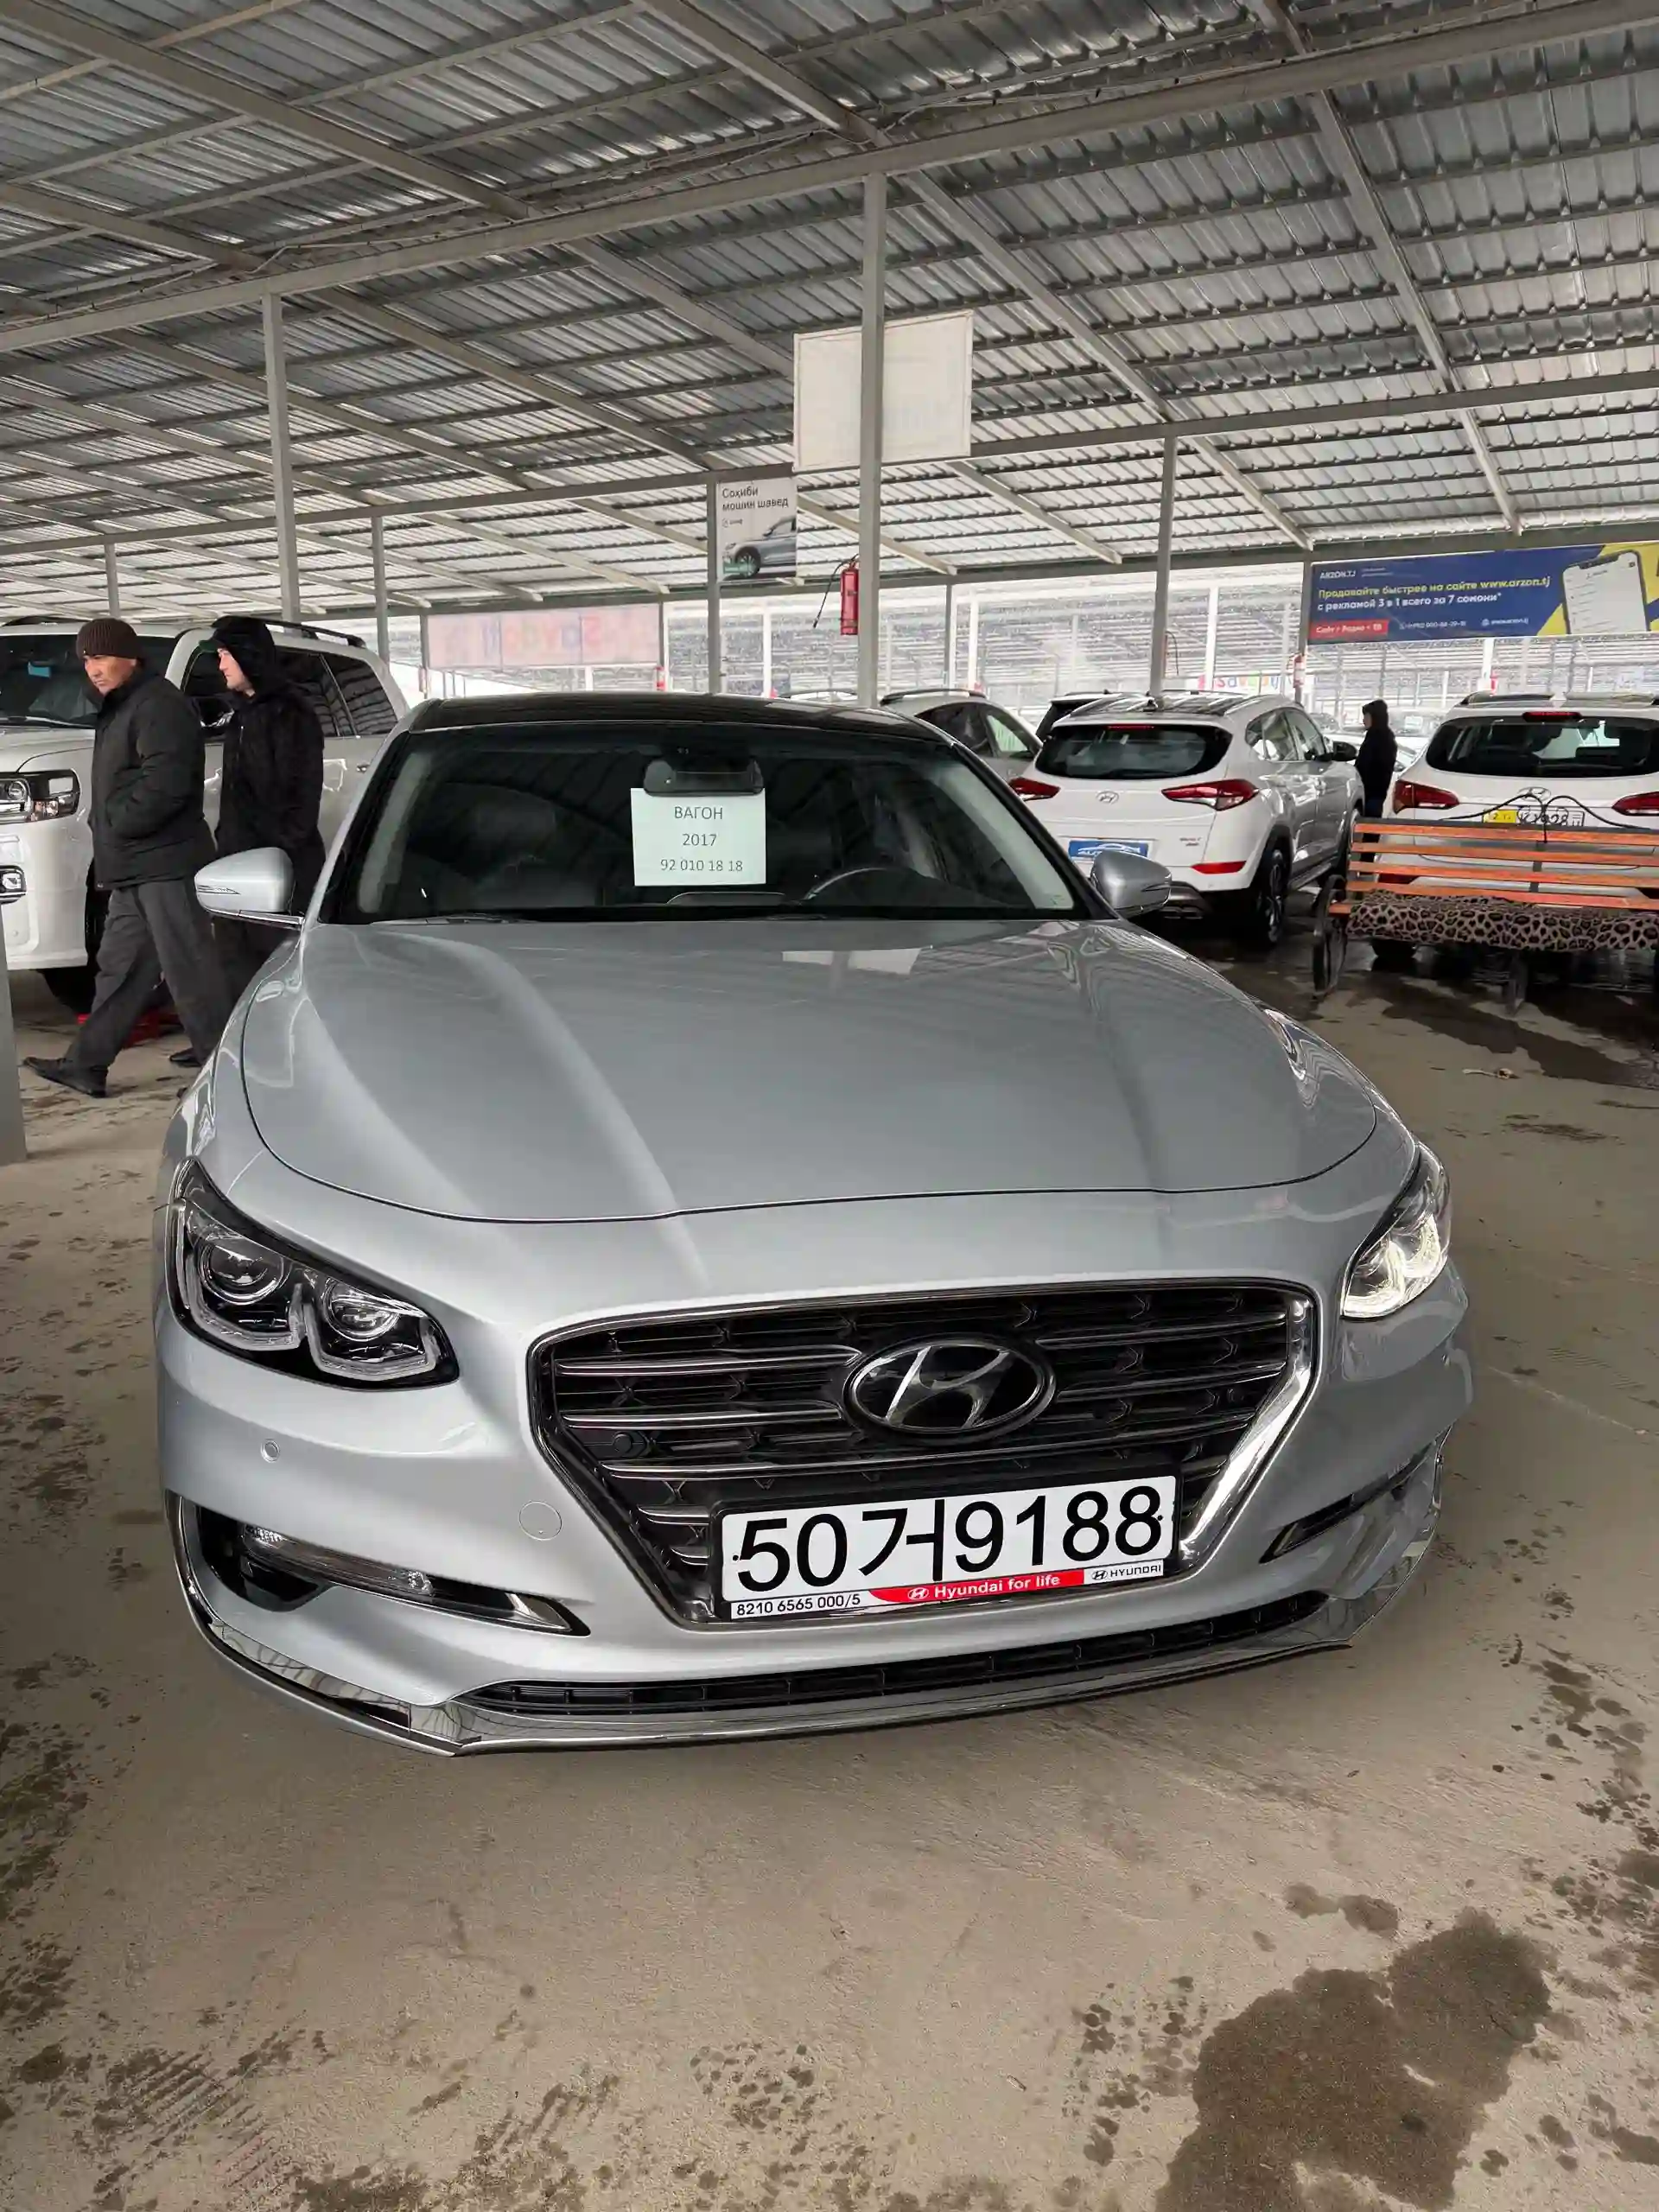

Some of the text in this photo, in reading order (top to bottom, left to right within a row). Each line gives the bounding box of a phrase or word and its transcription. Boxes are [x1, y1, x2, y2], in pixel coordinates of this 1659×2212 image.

[722, 498, 789, 512] мошин шавед
[1319, 587, 1380, 600] Продавайте
[1382, 584, 1427, 596] быстрее
[1446, 582, 1478, 591] сайте
[1479, 576, 1551, 589] www.arzon.tj
[1325, 599, 1376, 612] рекламой
[1378, 598, 1385, 607] 3
[1402, 598, 1432, 607] всего
[1447, 594, 1455, 605] 7
[674, 806, 723, 820] ВАГОН
[682, 833, 717, 847] 2017
[660, 859, 743, 872] 92 010 18 18
[738, 1485, 1162, 1592] 50거9188
[1109, 1563, 1161, 1578] HYUNDAI
[934, 1573, 1060, 1599] Hyundai for life
[736, 1593, 861, 1617] 8210 6565 000/5
